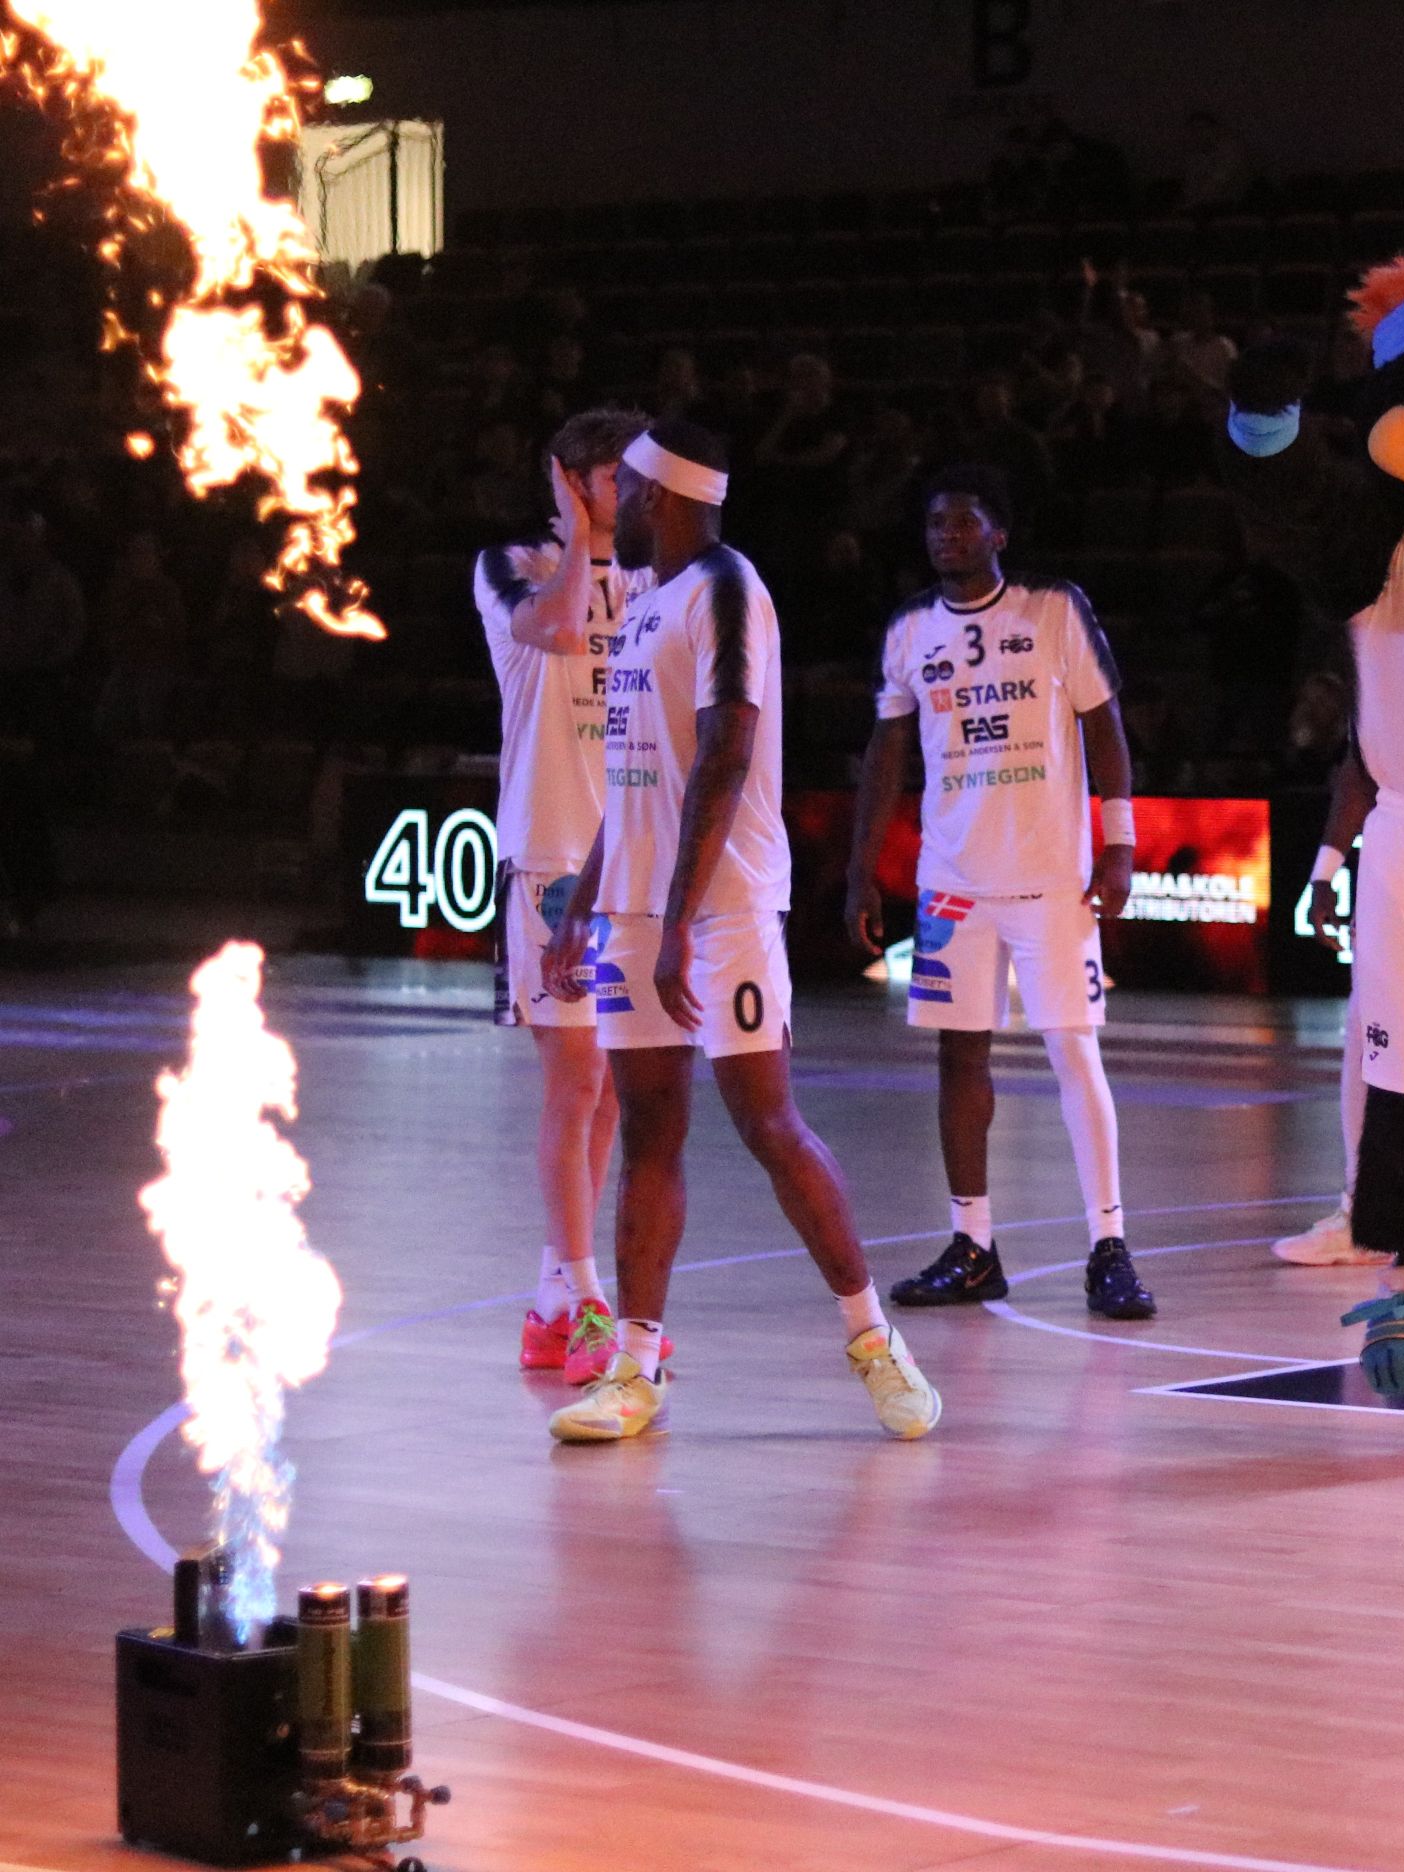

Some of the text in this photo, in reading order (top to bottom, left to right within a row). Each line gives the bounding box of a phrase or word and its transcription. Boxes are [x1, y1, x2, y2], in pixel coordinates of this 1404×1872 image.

[964, 624, 985, 667] 3
[955, 679, 1037, 708] STARK
[942, 764, 1046, 792] SYNTEGON
[365, 807, 497, 932] 40
[1085, 960, 1101, 1004] 3
[734, 981, 764, 1032] 0
